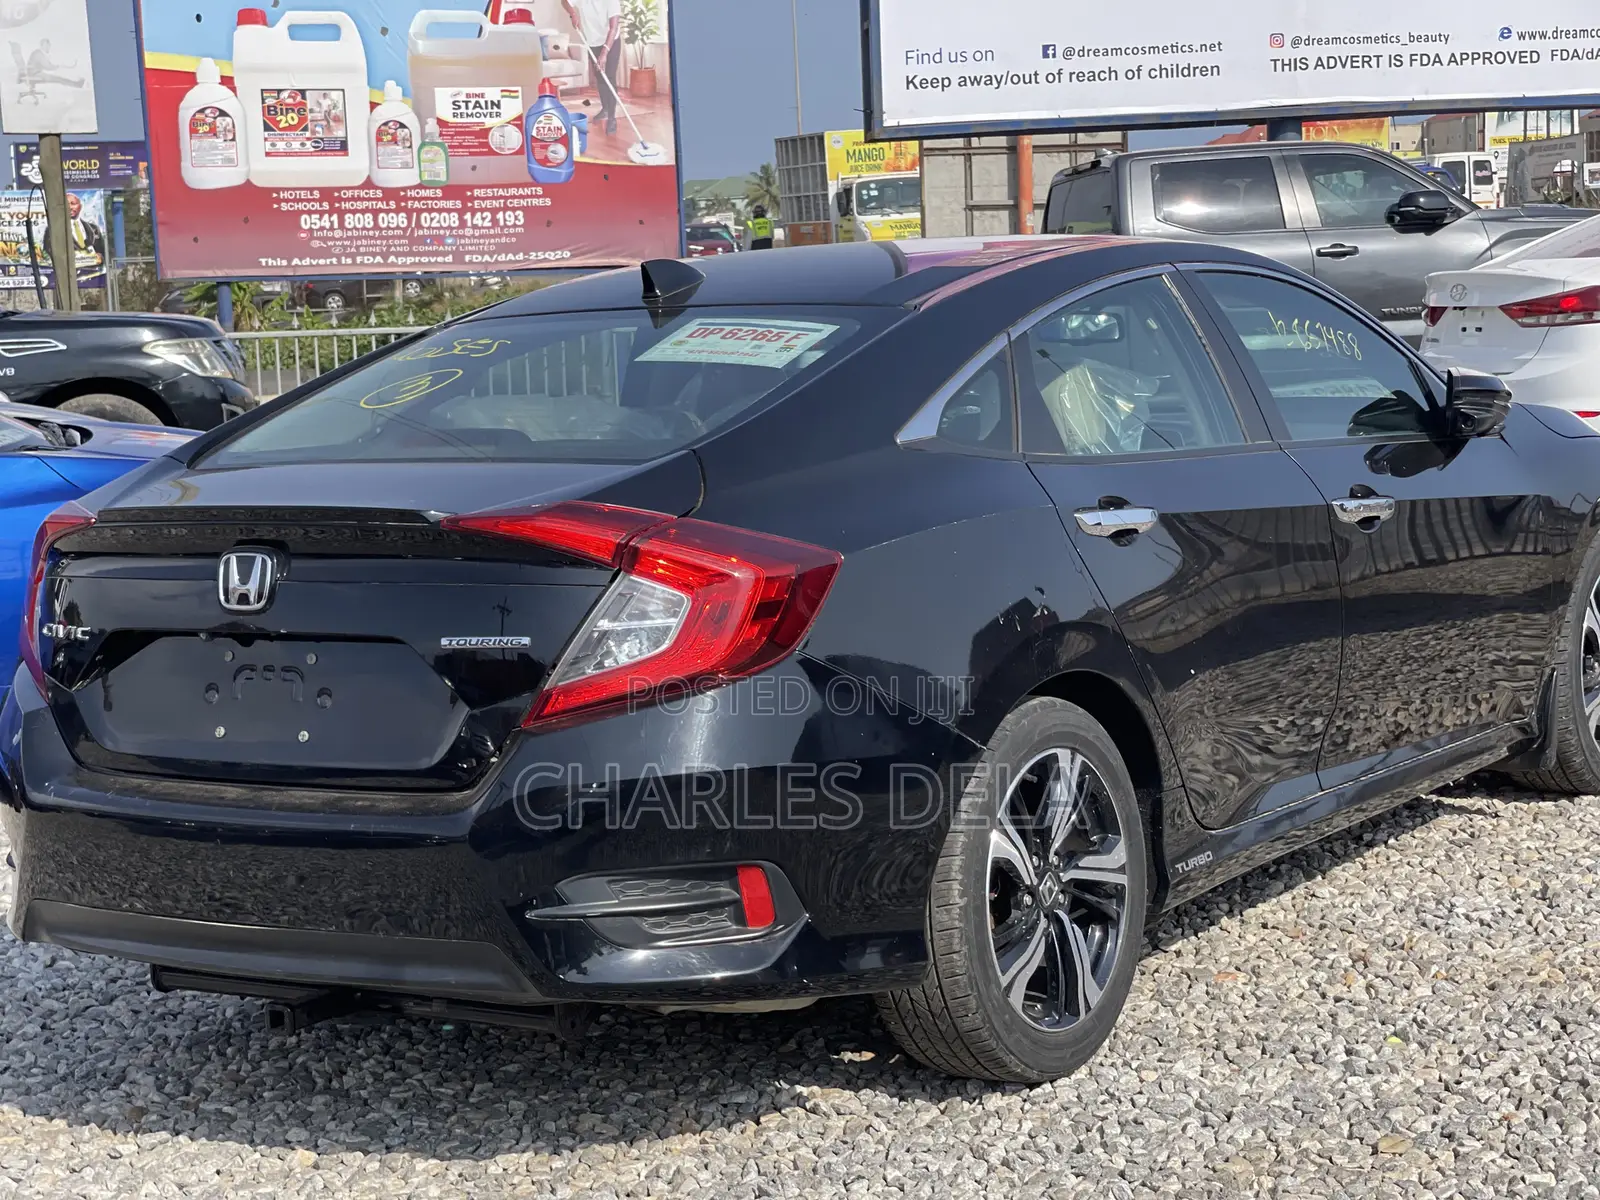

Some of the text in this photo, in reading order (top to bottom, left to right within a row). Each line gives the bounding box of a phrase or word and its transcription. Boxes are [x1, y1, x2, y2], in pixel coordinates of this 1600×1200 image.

[1290, 32, 1450, 49] @dreamcosmetics_beauty
[905, 48, 995, 65] Find us on
[1062, 41, 1223, 60] @dreamcosmetics.net
[1270, 50, 1541, 72] THIS ADVERT IS FDA APPROVED
[905, 62, 1221, 92] Keep away/out of reach of children
[266, 103, 308, 117] Bine
[452, 100, 502, 111] STAIN
[276, 112, 299, 128] 20
[452, 111, 502, 119] REMOVER
[846, 147, 886, 163] MANGO
[280, 187, 543, 198] HOTELS OFFICES HOMES RESTAURANTS
[280, 198, 551, 211] SCHOOLS HOSPITALS FACTORIES EVENT CENTRES
[300, 211, 524, 229] 0541 808 096 / 0208 142 193
[313, 229, 403, 238] info@jabiney.com
[414, 226, 524, 237] jabiney.co@gmail.com
[327, 238, 408, 247] www.jabiney.com
[456, 236, 517, 245] jabineyandco
[258, 257, 288, 266] This
[291, 256, 338, 266] Advert
[356, 255, 384, 264] FDA
[387, 254, 453, 265] Approved
[1381, 306, 1423, 317] TUND
[41, 622, 91, 641] CIVIC
[444, 637, 526, 648] TOURING
[1175, 850, 1213, 874] TURBO
